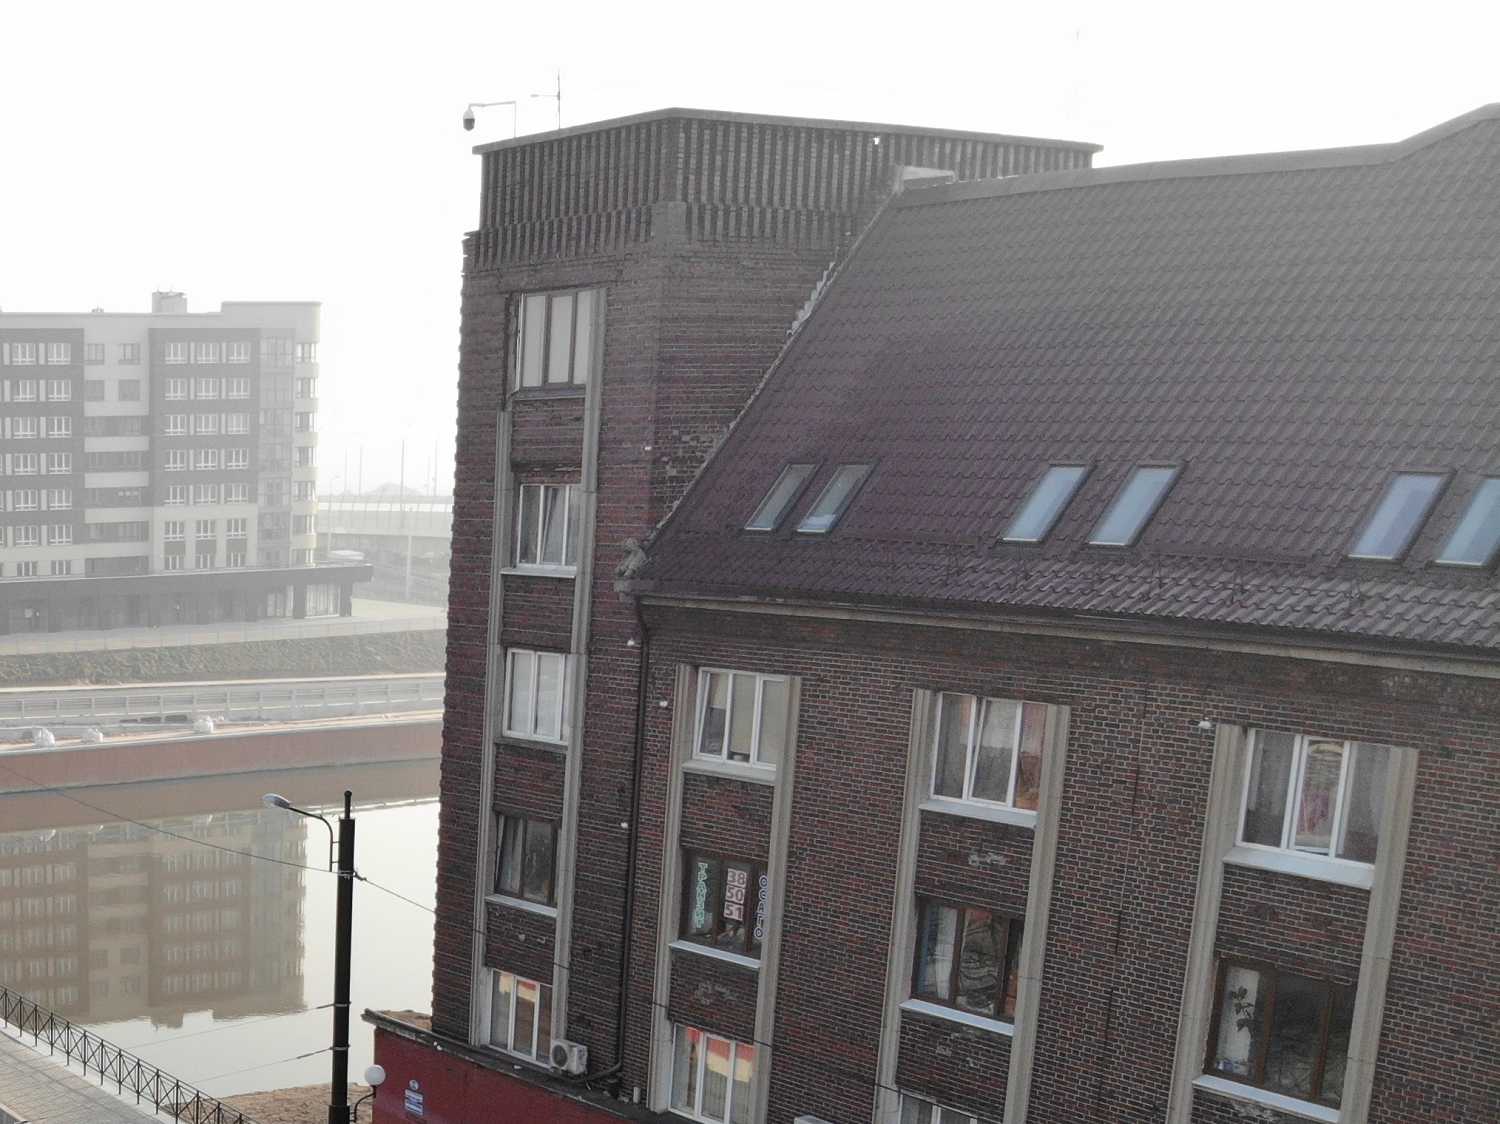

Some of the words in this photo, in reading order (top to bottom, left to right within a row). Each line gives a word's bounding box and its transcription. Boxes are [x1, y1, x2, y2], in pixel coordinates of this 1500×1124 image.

[728, 869, 746, 886] 38
[726, 886, 744, 902] 50
[725, 903, 744, 919] 51
